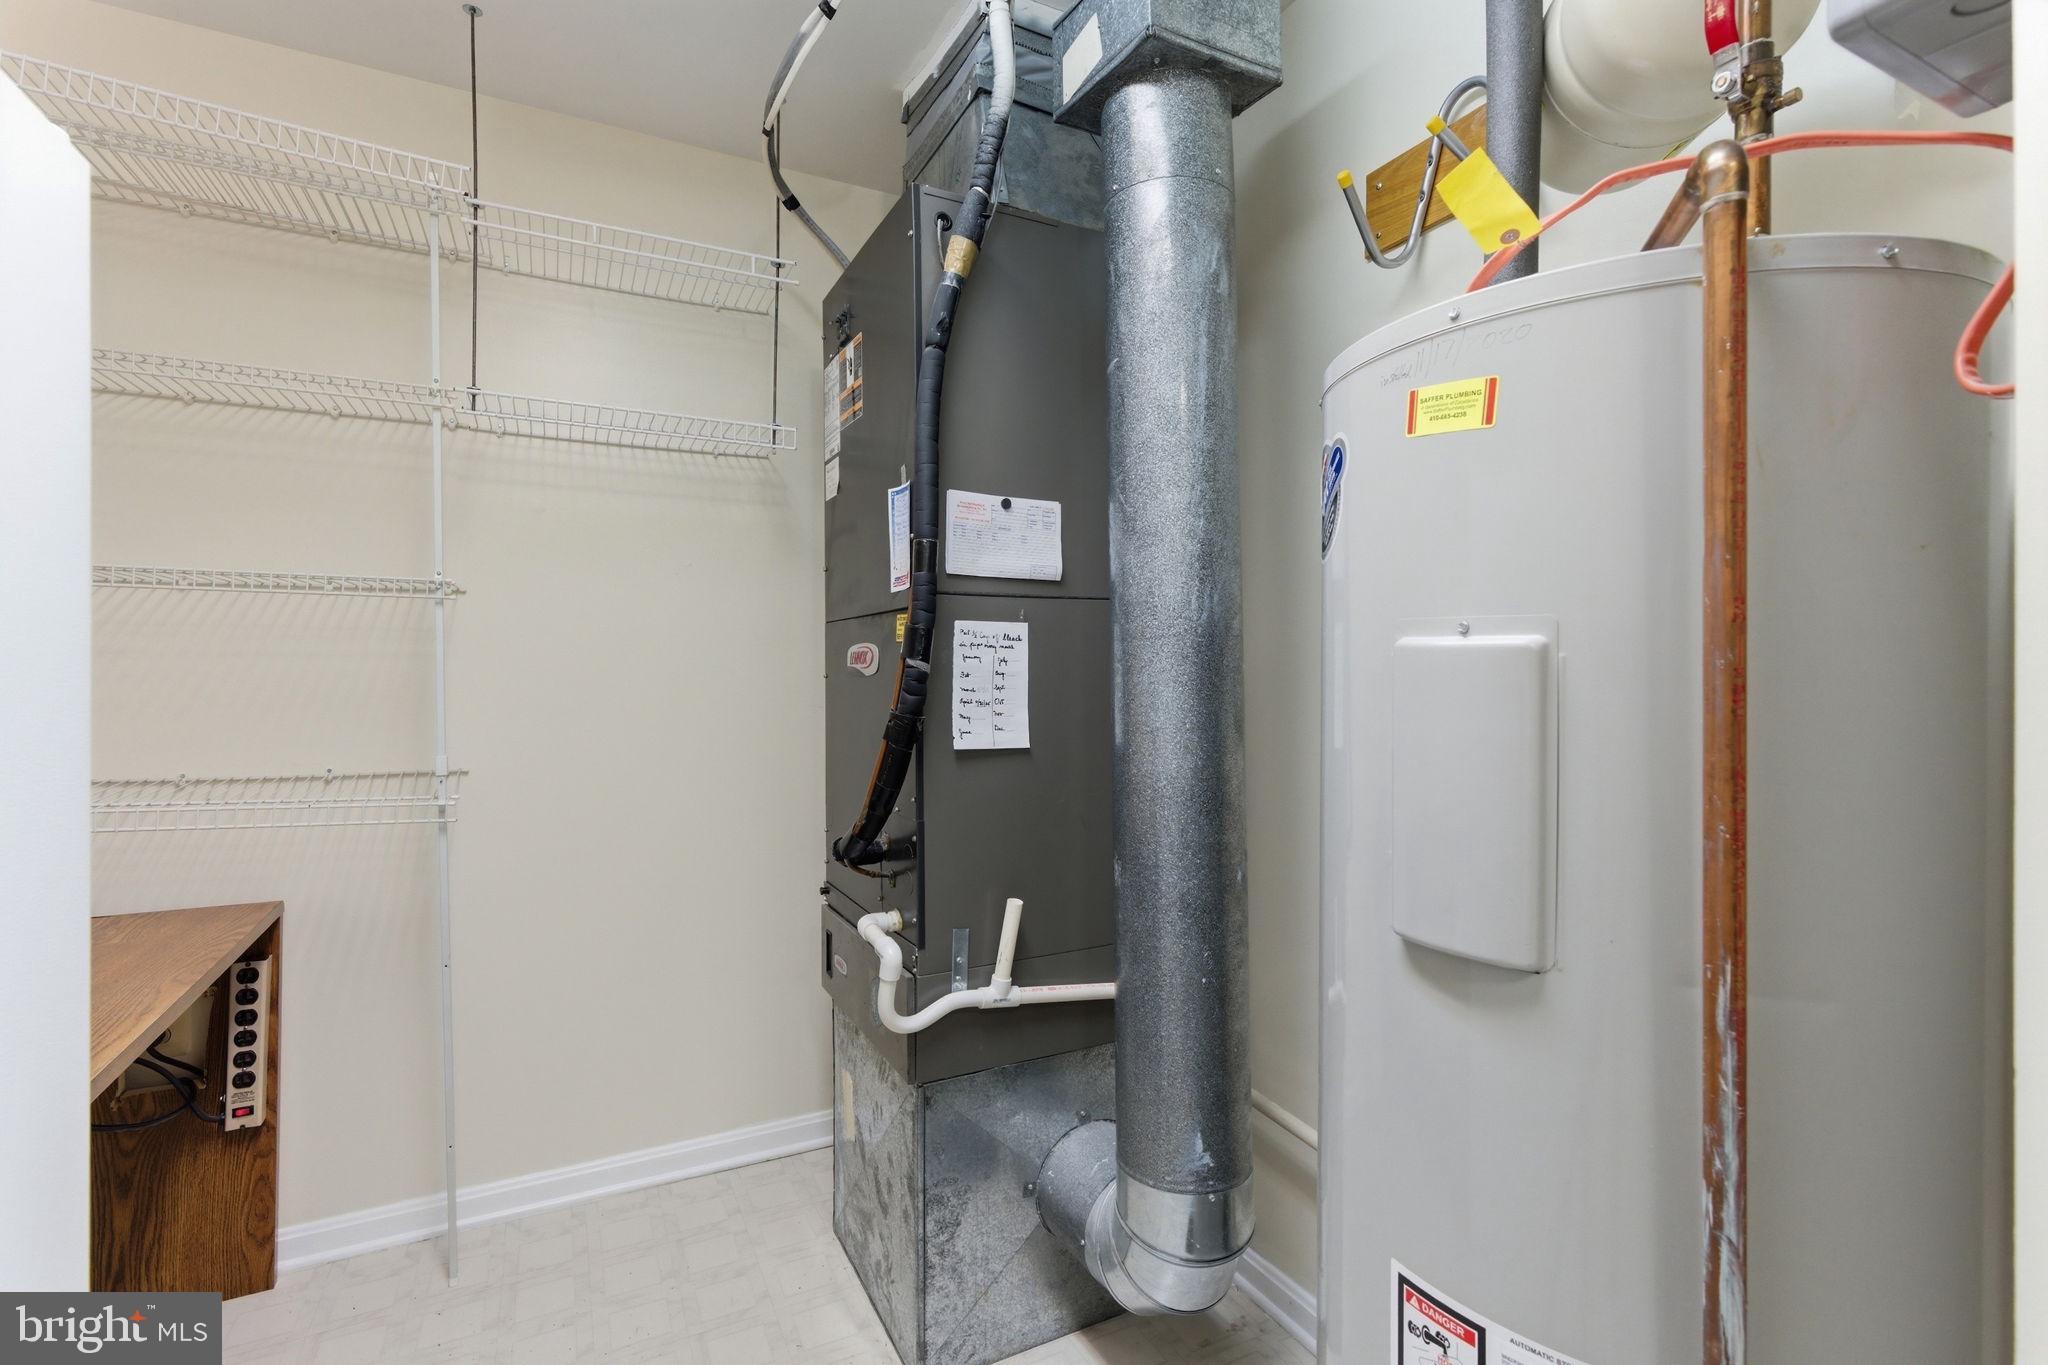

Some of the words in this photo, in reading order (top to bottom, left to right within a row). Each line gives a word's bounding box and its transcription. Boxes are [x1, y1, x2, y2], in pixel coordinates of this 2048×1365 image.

[1419, 394, 1445, 405] SAFFER
[1445, 389, 1482, 400] PLUMBING
[1421, 1302, 1466, 1338] DANGER
[1509, 1337, 1555, 1363] AUTOMATIC
